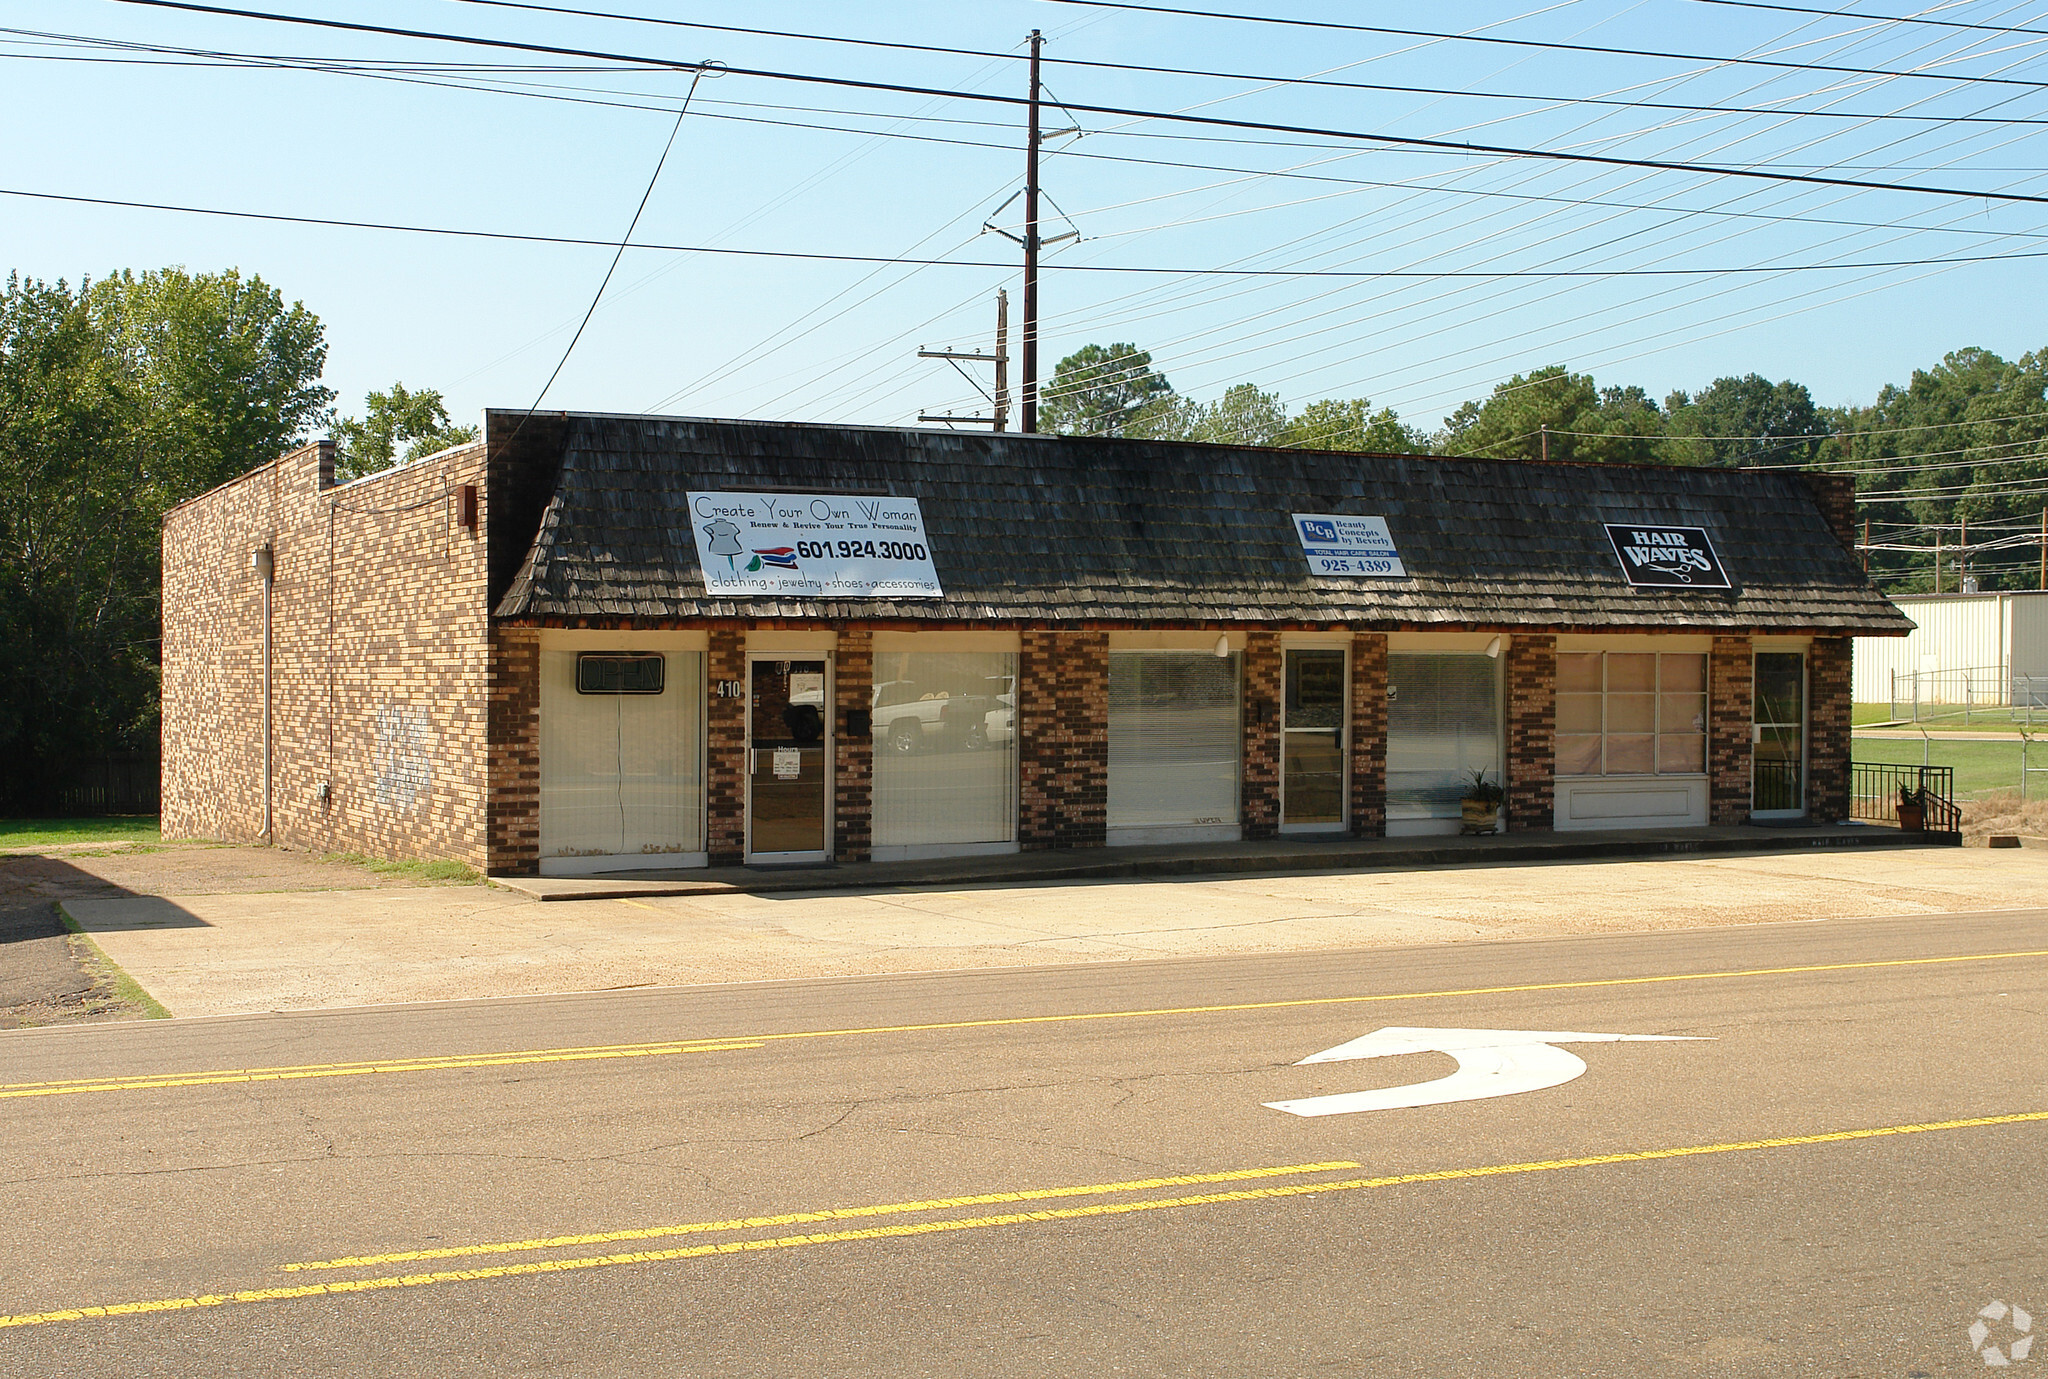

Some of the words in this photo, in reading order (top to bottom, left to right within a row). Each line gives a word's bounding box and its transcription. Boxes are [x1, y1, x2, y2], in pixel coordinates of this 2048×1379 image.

[695, 497, 755, 518] Create
[760, 498, 802, 519] Your
[810, 499, 850, 521] Own
[856, 500, 917, 521] Woman
[825, 522, 844, 530] Your
[872, 523, 918, 532] Personality
[1305, 522, 1335, 539] BCB
[1336, 521, 1366, 529] Beauty
[1339, 529, 1379, 538] Concepts
[1342, 537, 1352, 545] by
[1356, 537, 1389, 546] Beverly
[1631, 531, 1688, 546] HAIR
[797, 541, 927, 561] 601.924.3000
[1623, 546, 1711, 571] WAVES
[1321, 559, 1391, 572] 925-4389
[712, 571, 768, 590] clothing
[777, 571, 822, 591] jewelry
[832, 572, 863, 589] shoes
[871, 578, 935, 590] accessories
[584, 660, 659, 689] OPEN
[717, 681, 740, 697] 410
